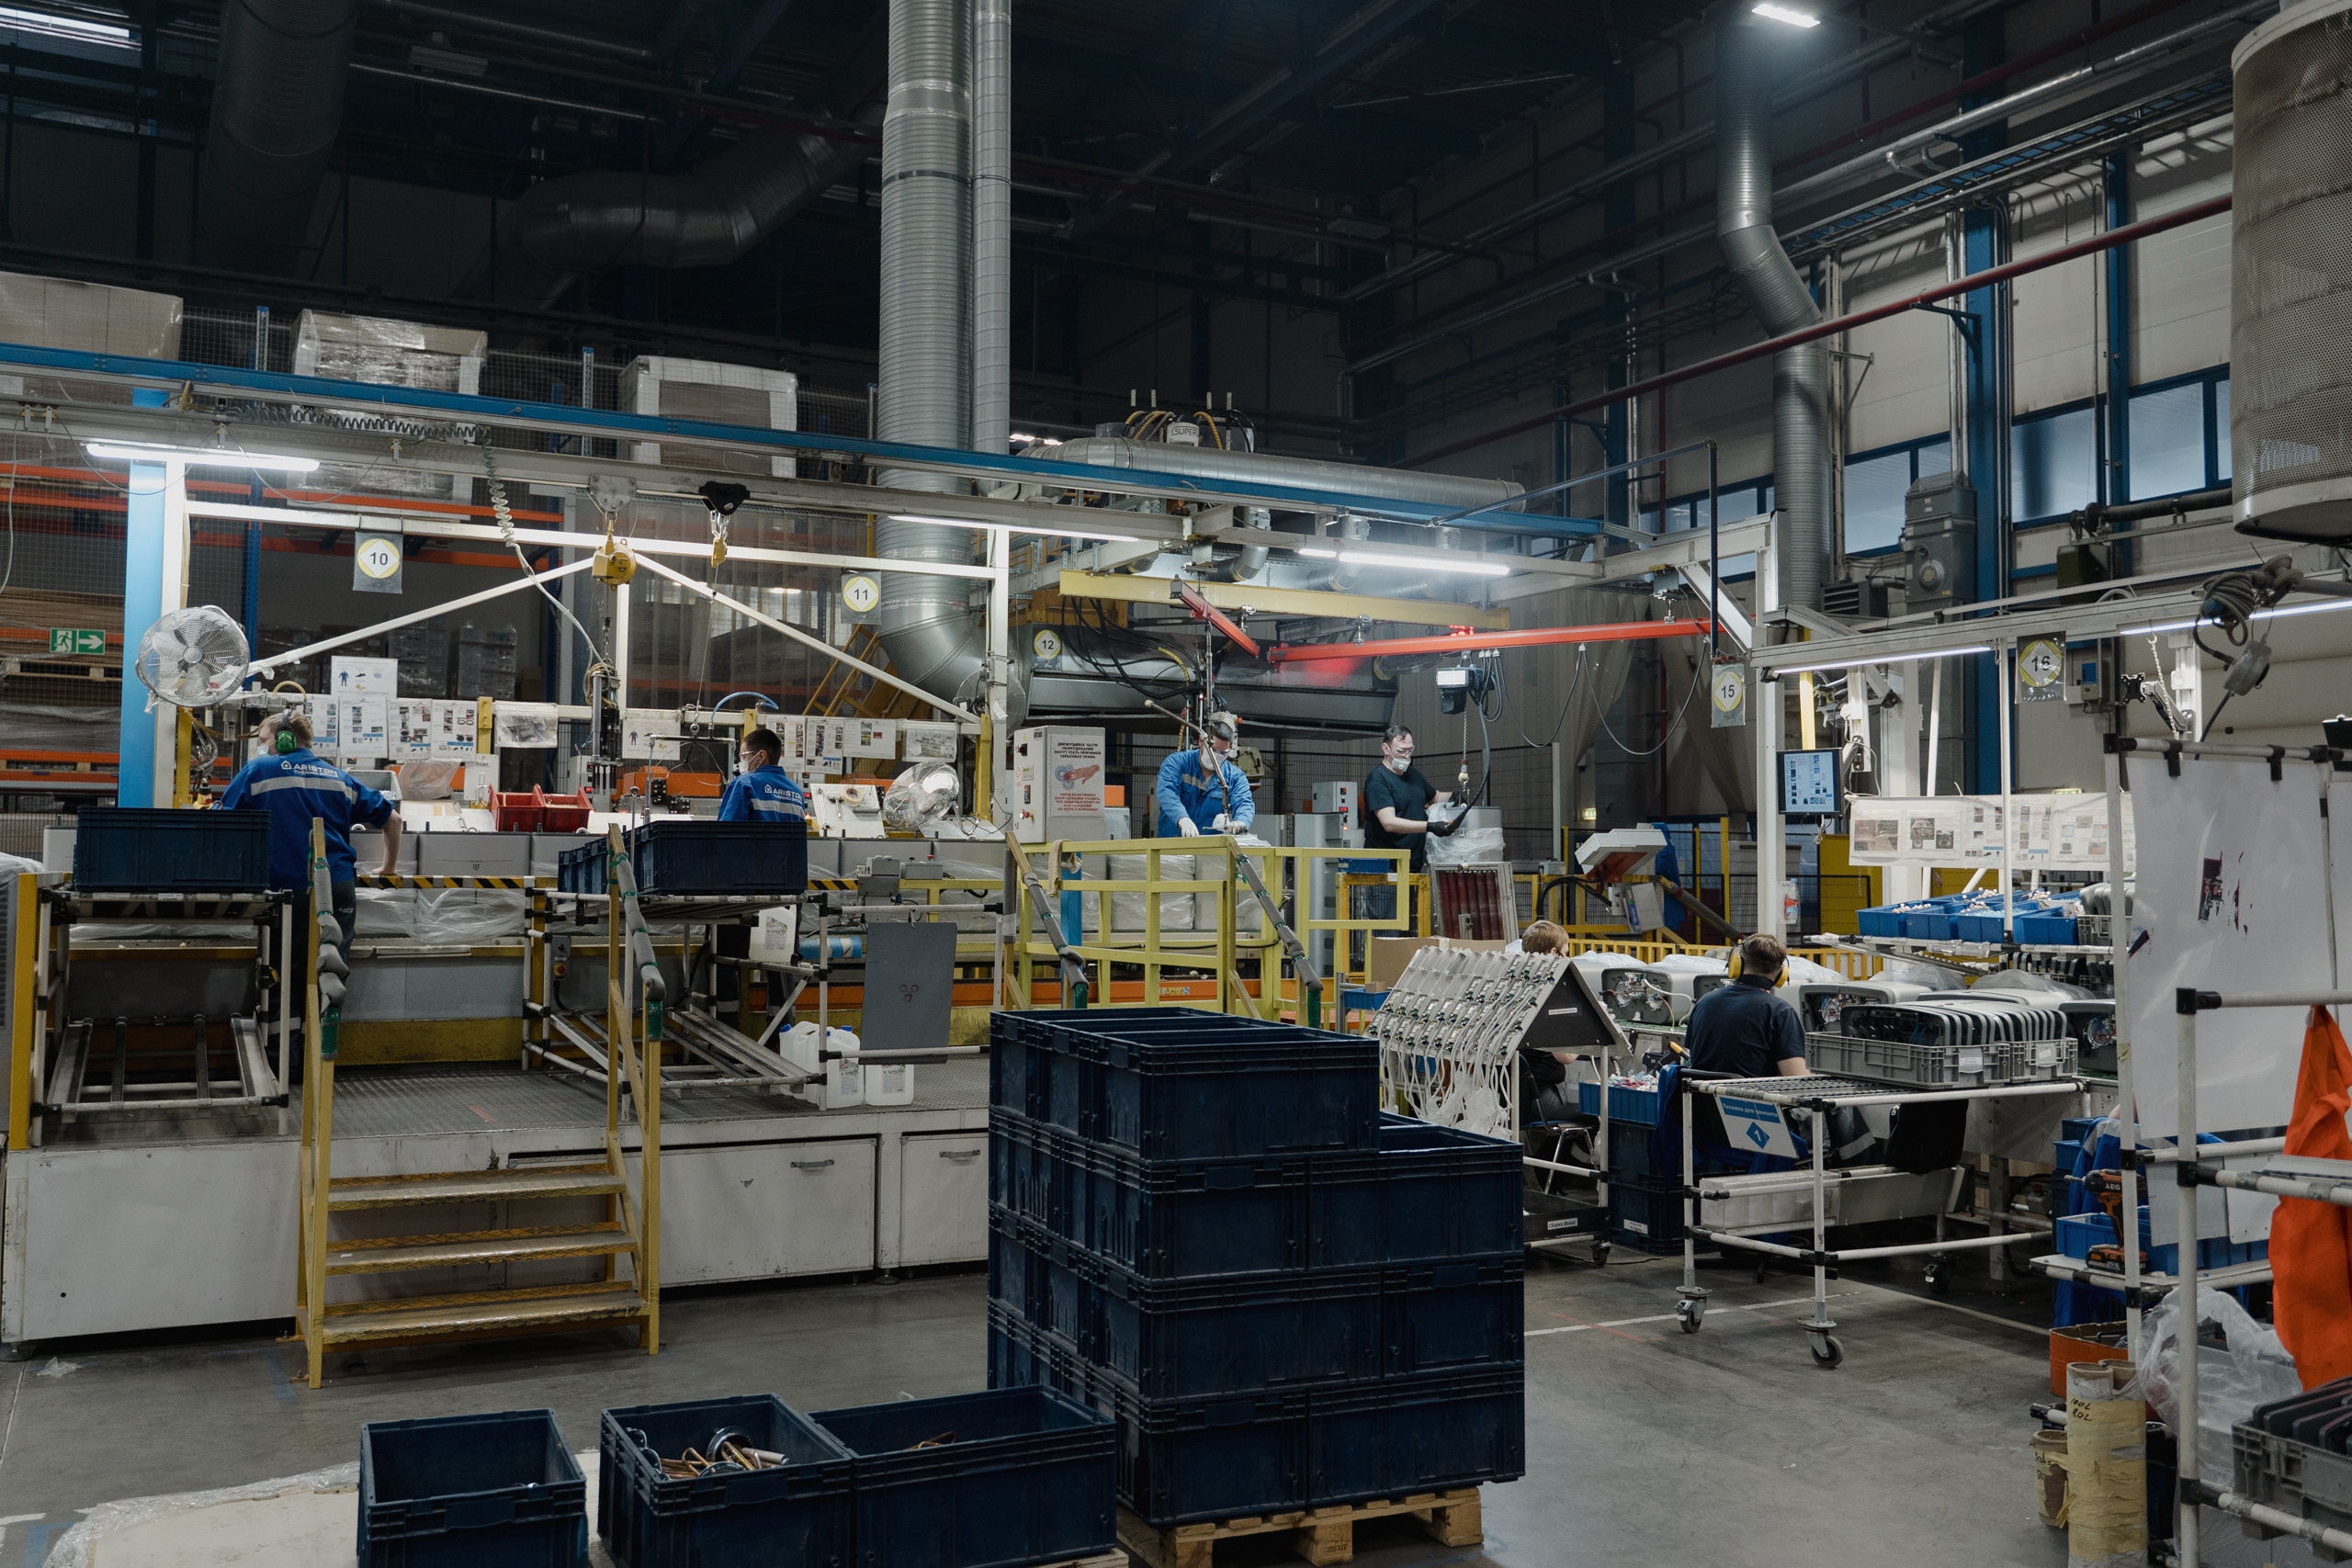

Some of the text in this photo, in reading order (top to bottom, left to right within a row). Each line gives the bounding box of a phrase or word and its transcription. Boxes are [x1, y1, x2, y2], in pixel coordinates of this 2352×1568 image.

[370, 552, 388, 565] 10
[854, 589, 867, 600] 11
[1042, 639, 1054, 649] 12
[2031, 655, 2050, 671] 16
[1721, 684, 1735, 698] 15
[294, 763, 338, 775] ARISTON
[1723, 1103, 1744, 1112] Тележка
[1756, 1110, 1778, 1118] ремонта
[1754, 1129, 1761, 1142] 1
